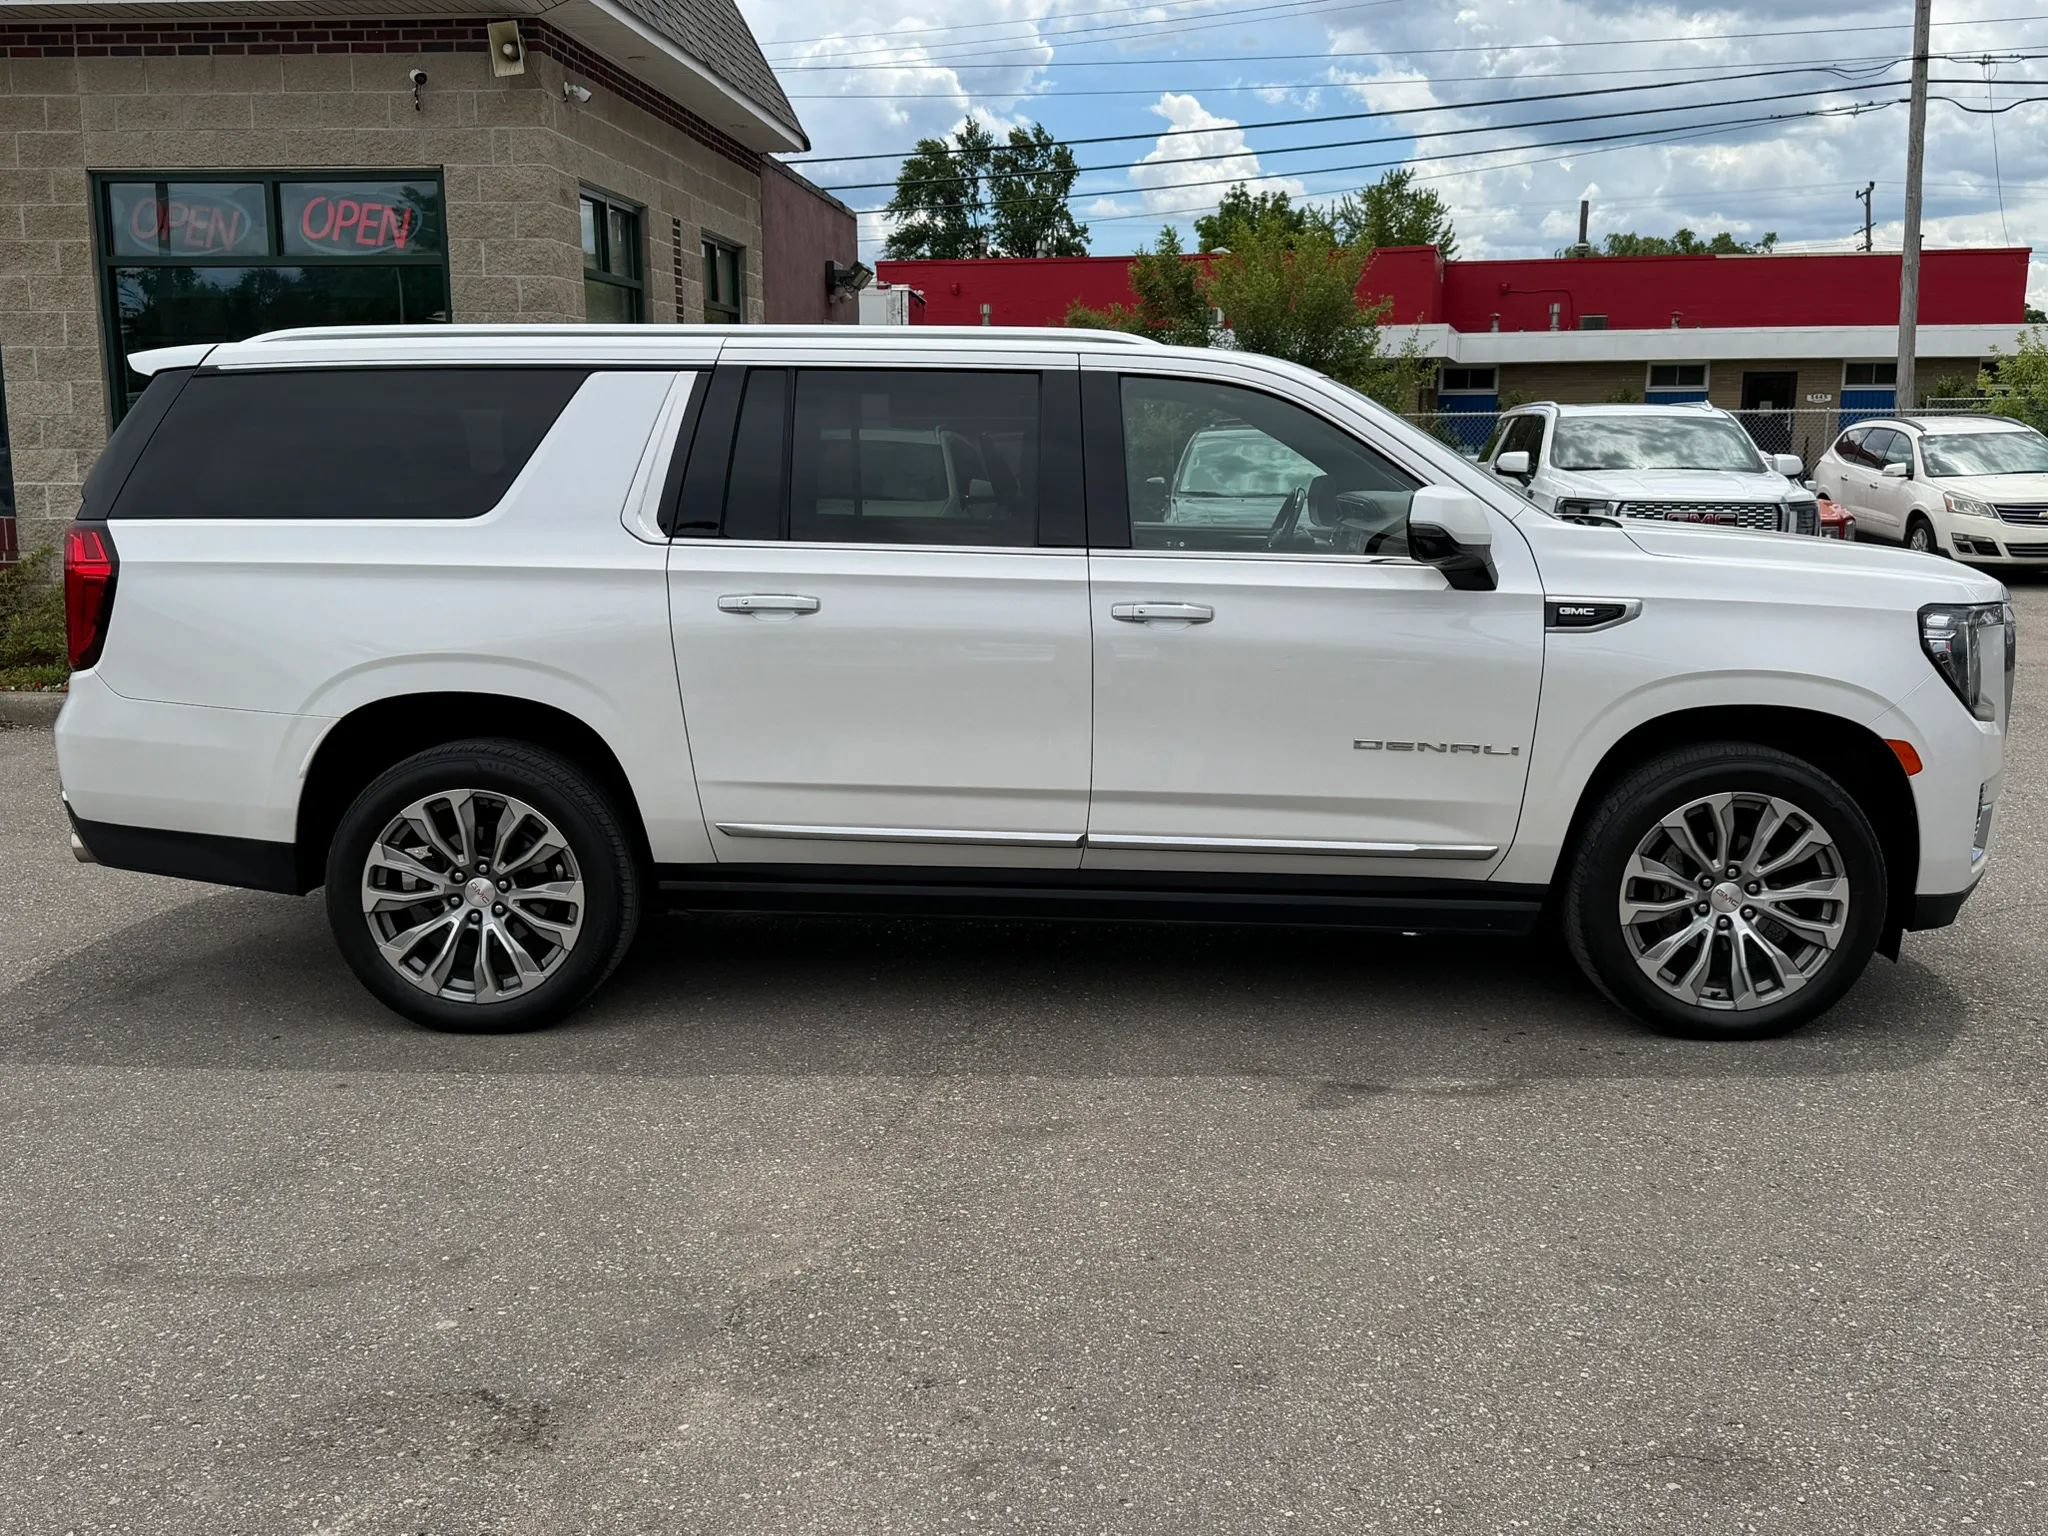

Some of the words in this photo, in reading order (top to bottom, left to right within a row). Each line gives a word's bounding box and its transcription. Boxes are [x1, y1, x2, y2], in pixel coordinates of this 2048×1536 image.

[131, 198, 240, 249] OPEN
[303, 196, 412, 249] OPEN
[1559, 606, 1595, 616] GMC
[1353, 738, 1519, 756] DENALI
[470, 881, 490, 904] GMC
[1715, 888, 1739, 907] GMC
